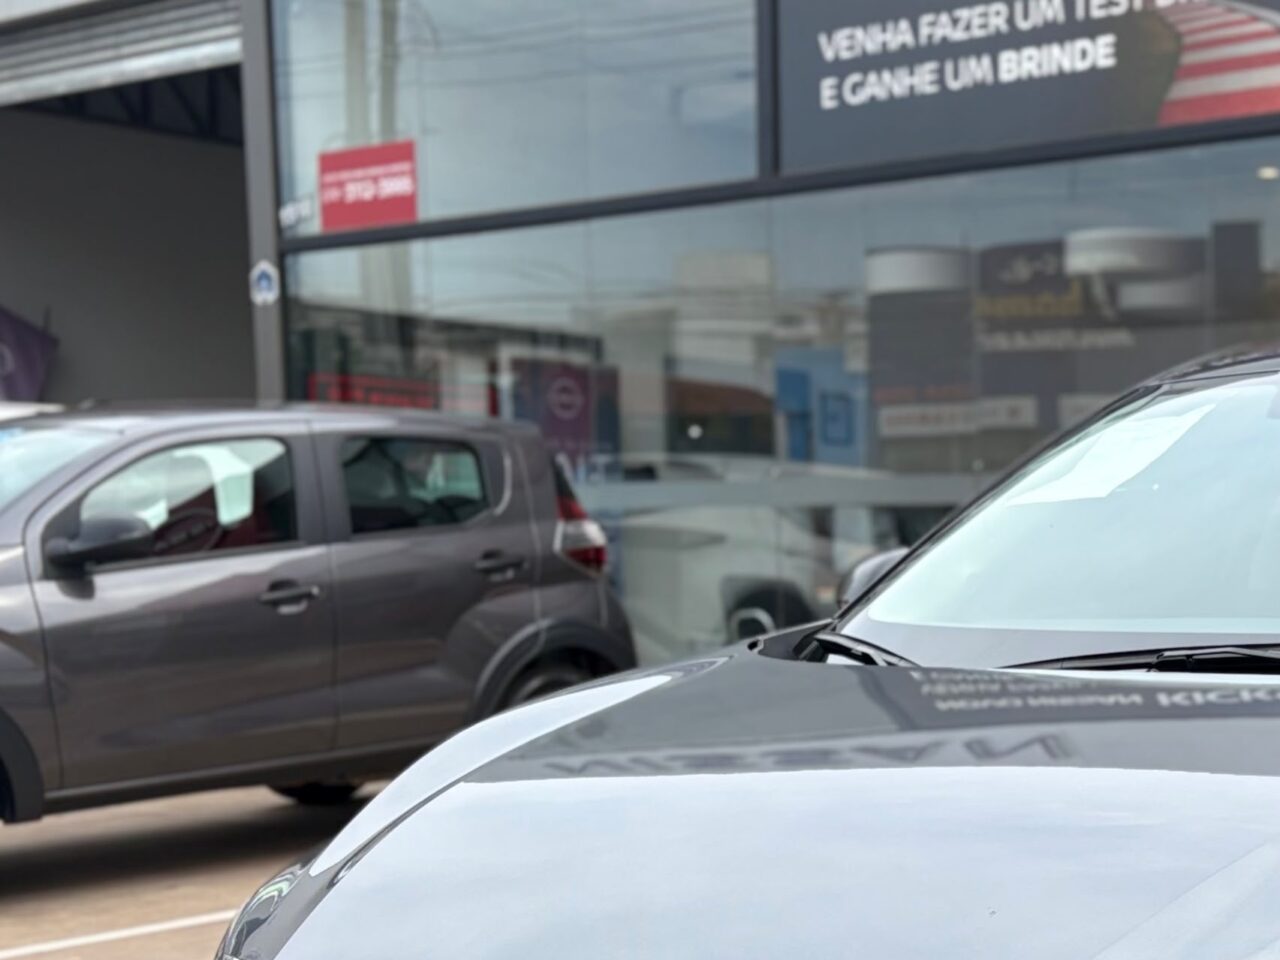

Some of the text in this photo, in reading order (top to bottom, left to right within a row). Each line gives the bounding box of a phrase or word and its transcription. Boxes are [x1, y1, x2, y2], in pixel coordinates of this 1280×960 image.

[818, 18, 916, 63] VENHA
[918, 2, 1008, 47] FAZER
[1014, 0, 1066, 31] UM
[819, 33, 1117, 110] E GANHE UM BRINDE
